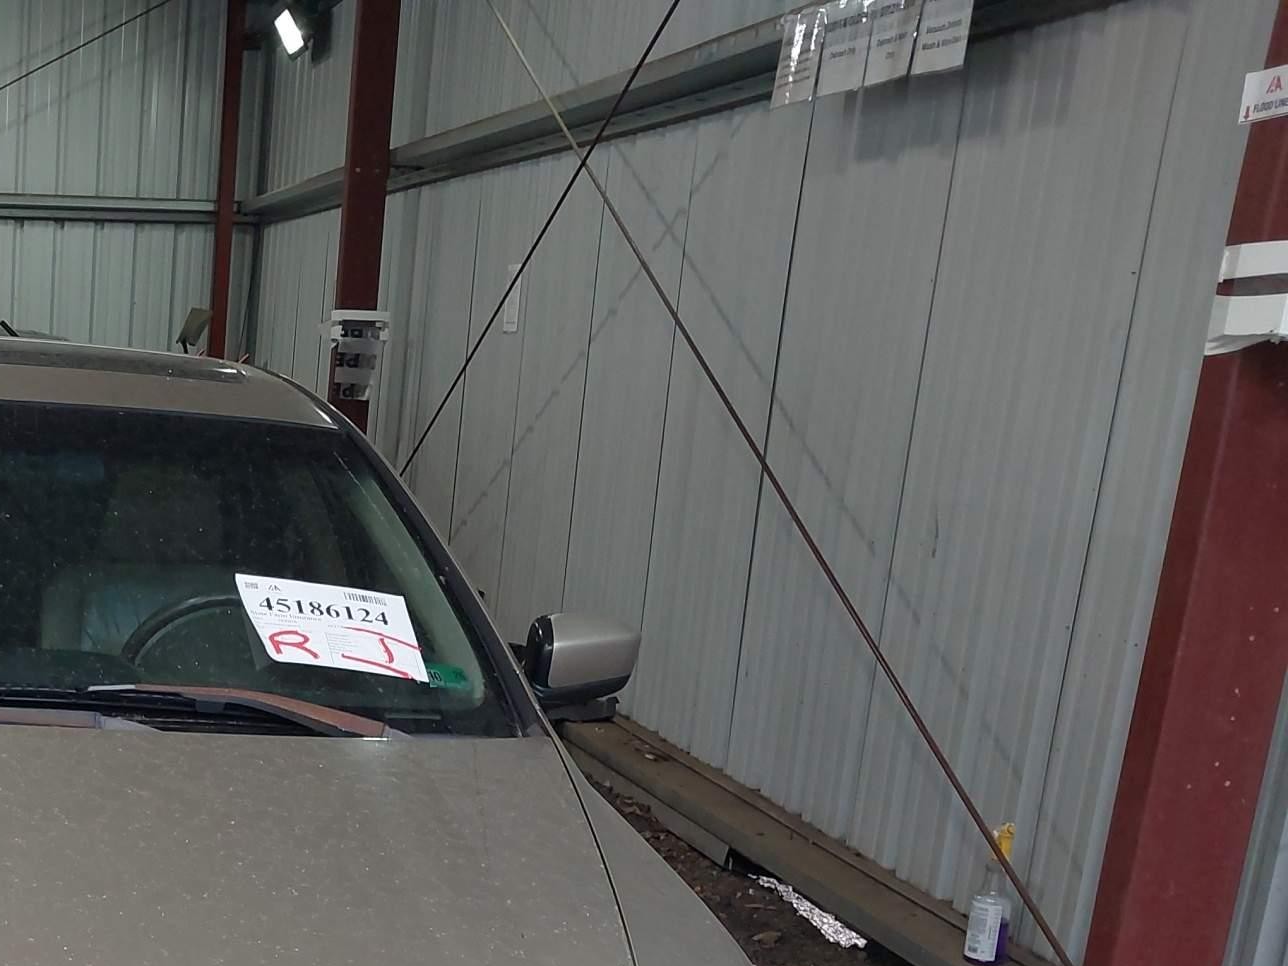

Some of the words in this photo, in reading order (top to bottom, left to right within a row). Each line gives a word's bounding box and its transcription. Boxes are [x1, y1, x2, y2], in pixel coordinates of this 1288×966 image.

[1253, 100, 1274, 113] FLOOD
[258, 596, 389, 626] 45186124
[268, 630, 320, 660] R
